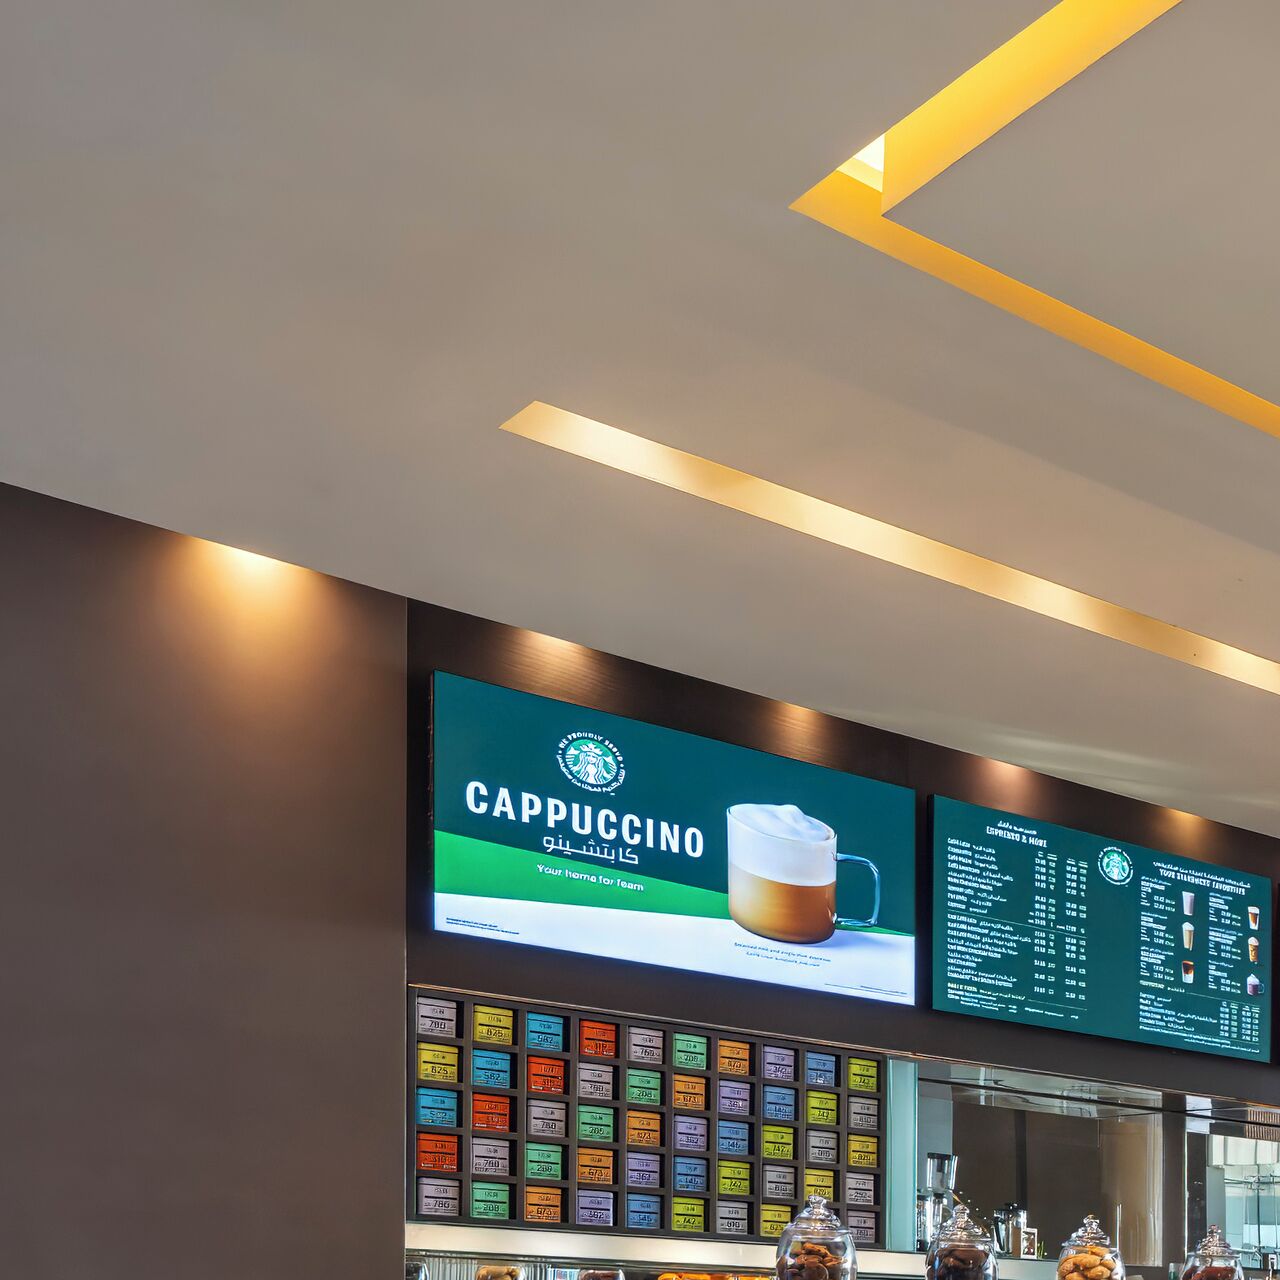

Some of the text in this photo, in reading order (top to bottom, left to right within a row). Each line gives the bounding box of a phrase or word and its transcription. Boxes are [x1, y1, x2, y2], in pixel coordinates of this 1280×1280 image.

[465, 780, 704, 858] CAPPUCCINO
[542, 834, 639, 865] كابتشينو
[536, 863, 562, 877] Your
[565, 869, 597, 884] home
[599, 875, 614, 886] for
